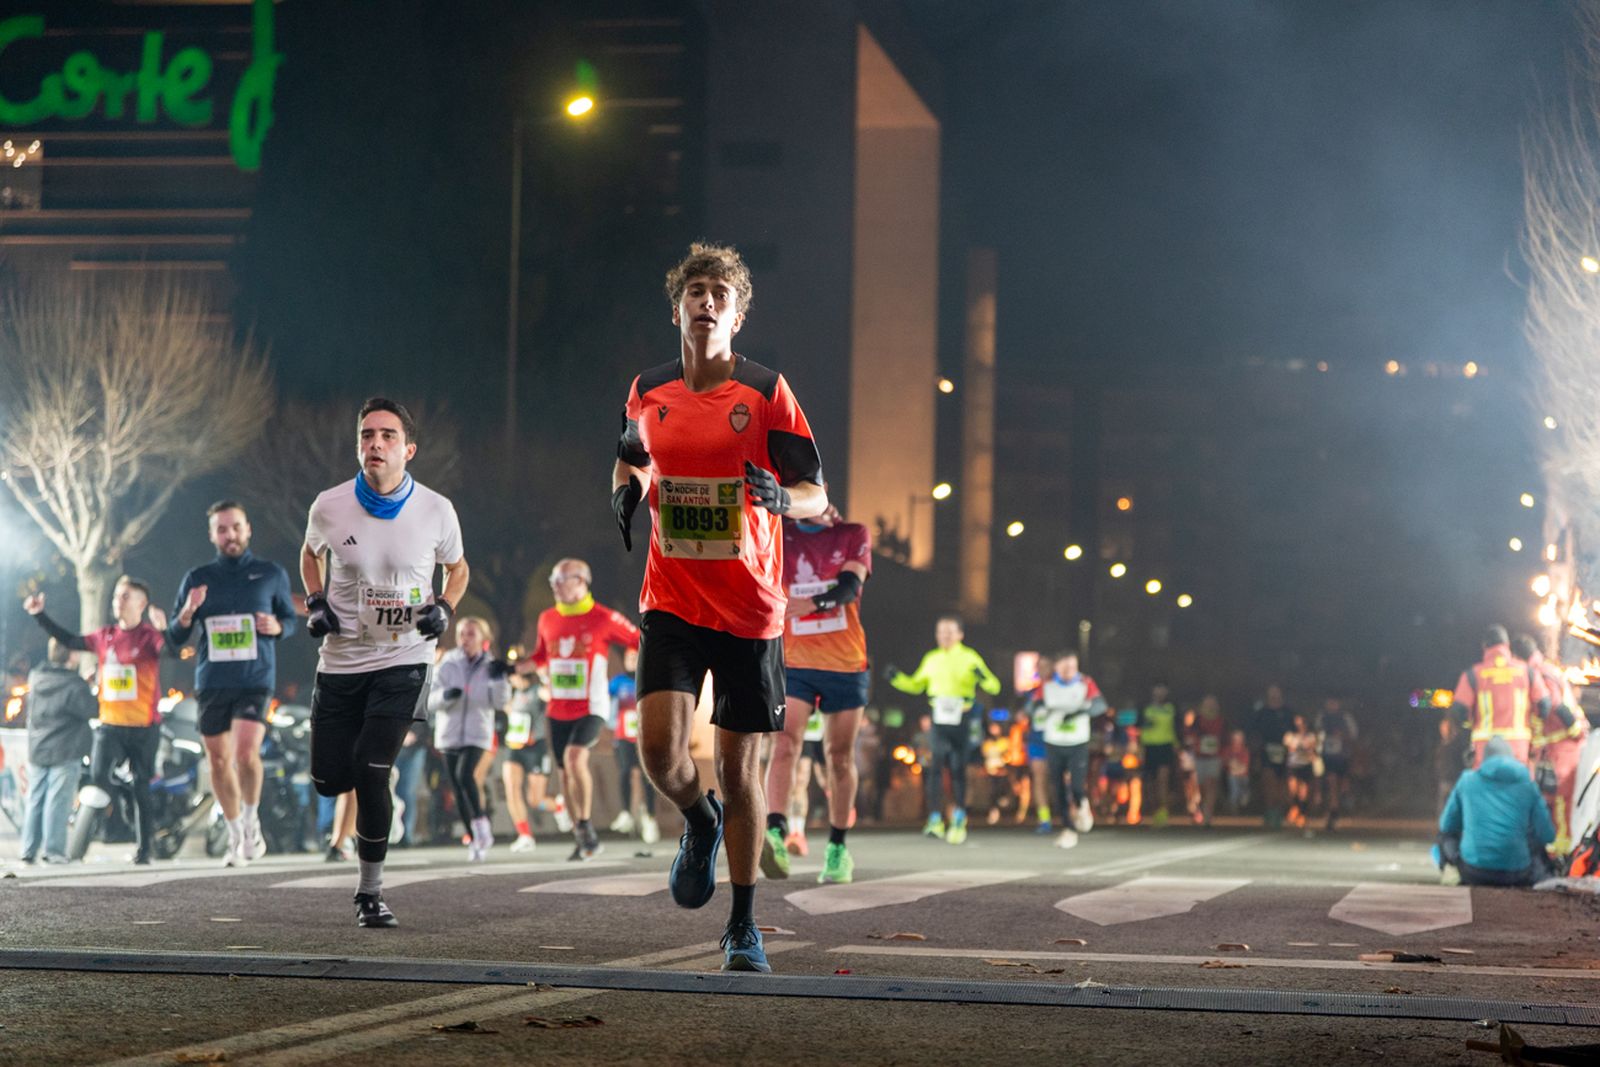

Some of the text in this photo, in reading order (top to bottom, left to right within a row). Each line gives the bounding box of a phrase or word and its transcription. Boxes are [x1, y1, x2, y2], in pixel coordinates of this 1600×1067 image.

[674, 486, 710, 495] NOCHE DE
[666, 495, 682, 504] SAN
[672, 506, 729, 532] 8893
[375, 607, 412, 625] 7124
